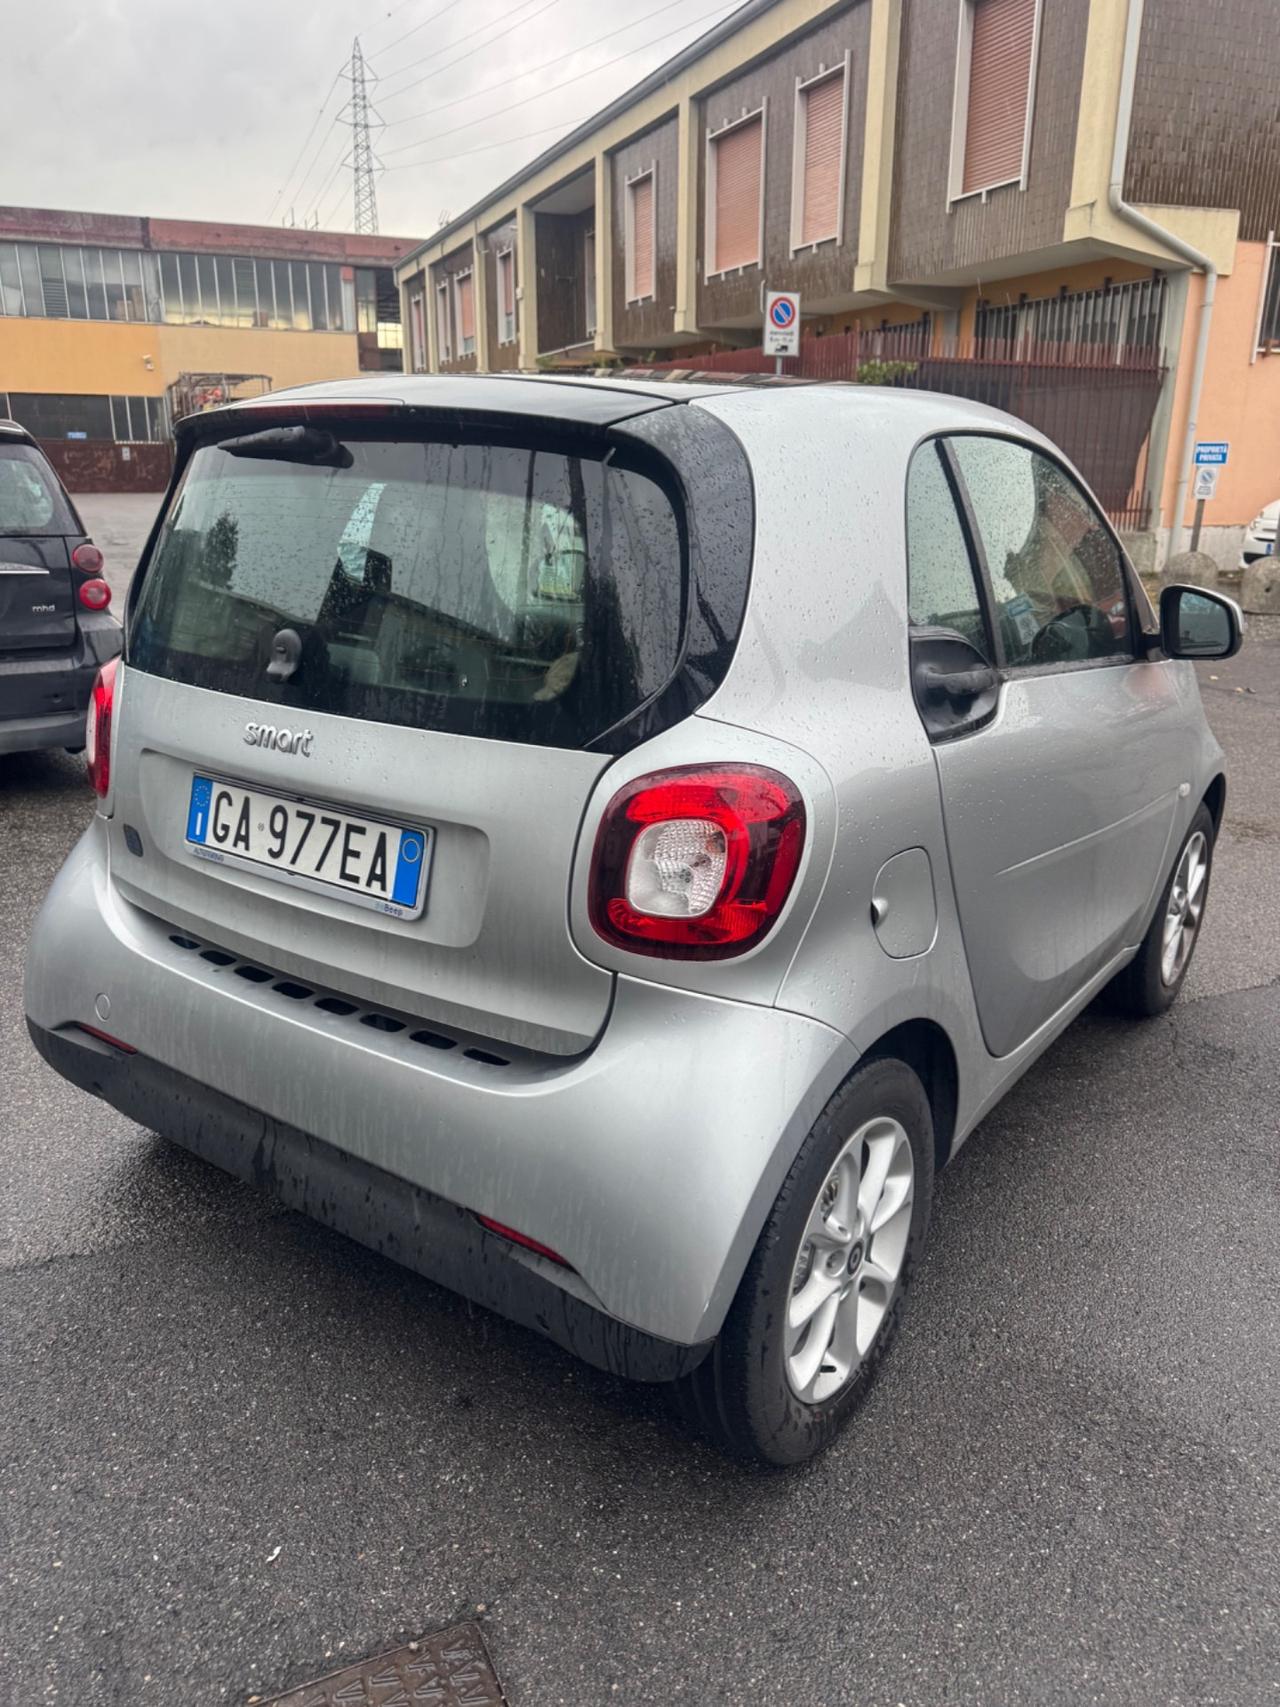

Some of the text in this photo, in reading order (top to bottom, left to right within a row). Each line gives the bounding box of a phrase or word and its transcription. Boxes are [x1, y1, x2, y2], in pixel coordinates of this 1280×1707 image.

[32, 604, 55, 612] mhd
[243, 722, 314, 757] smart
[212, 790, 388, 893] GA 977EA
